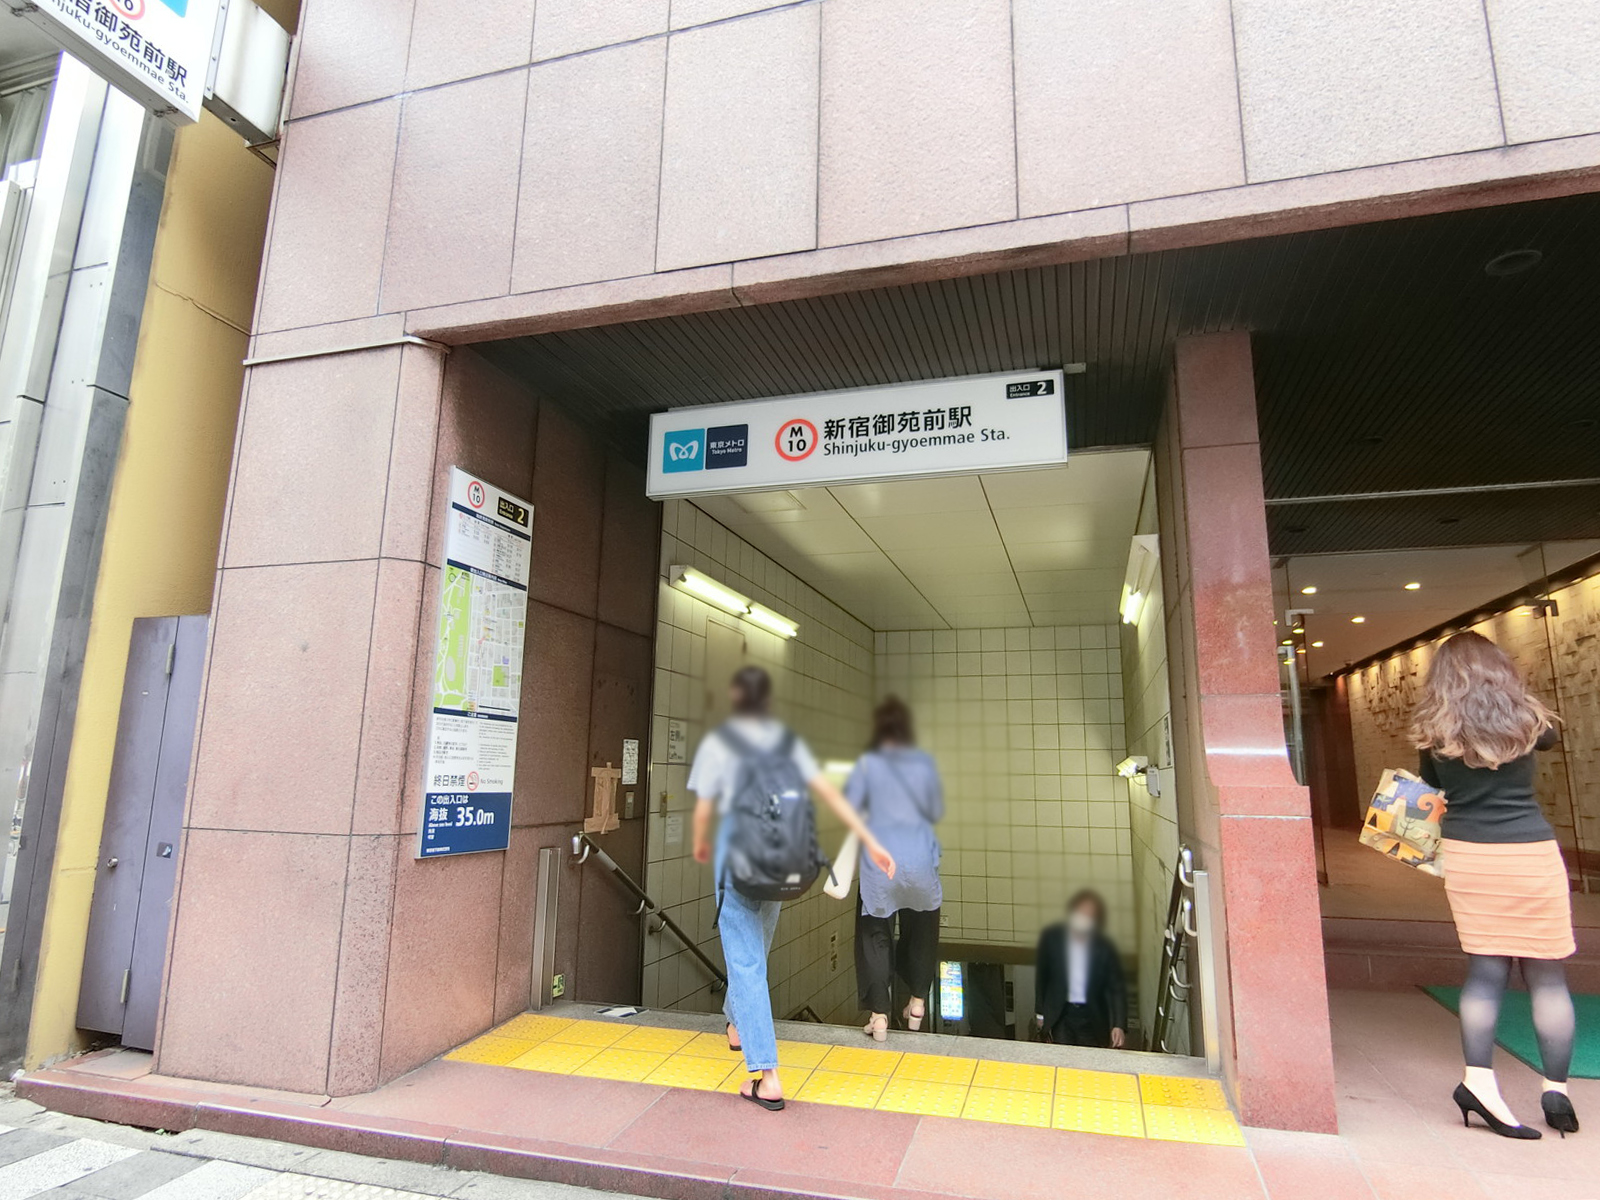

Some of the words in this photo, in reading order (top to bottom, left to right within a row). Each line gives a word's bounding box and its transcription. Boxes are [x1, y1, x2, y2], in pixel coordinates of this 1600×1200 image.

[168, 80, 189, 103] Sta.
[1009, 384, 1030, 392] 出入口
[1036, 381, 1047, 396] 2
[823, 405, 972, 440] 新宿御苑前駅
[789, 426, 803, 438] M
[709, 439, 745, 450] 東京メトロ
[788, 439, 807, 452] 10
[823, 432, 975, 457] Shinjuku-gyoemmae
[980, 428, 1010, 442] Sta.
[711, 448, 727, 456] Tokyo
[726, 446, 743, 454] Metro
[472, 493, 481, 503] 10
[517, 508, 525, 524] 2
[433, 774, 466, 787] 終日禁煙
[486, 778, 503, 786] Smoking
[430, 795, 469, 805] この出入口は
[455, 806, 495, 827] 35.0m
